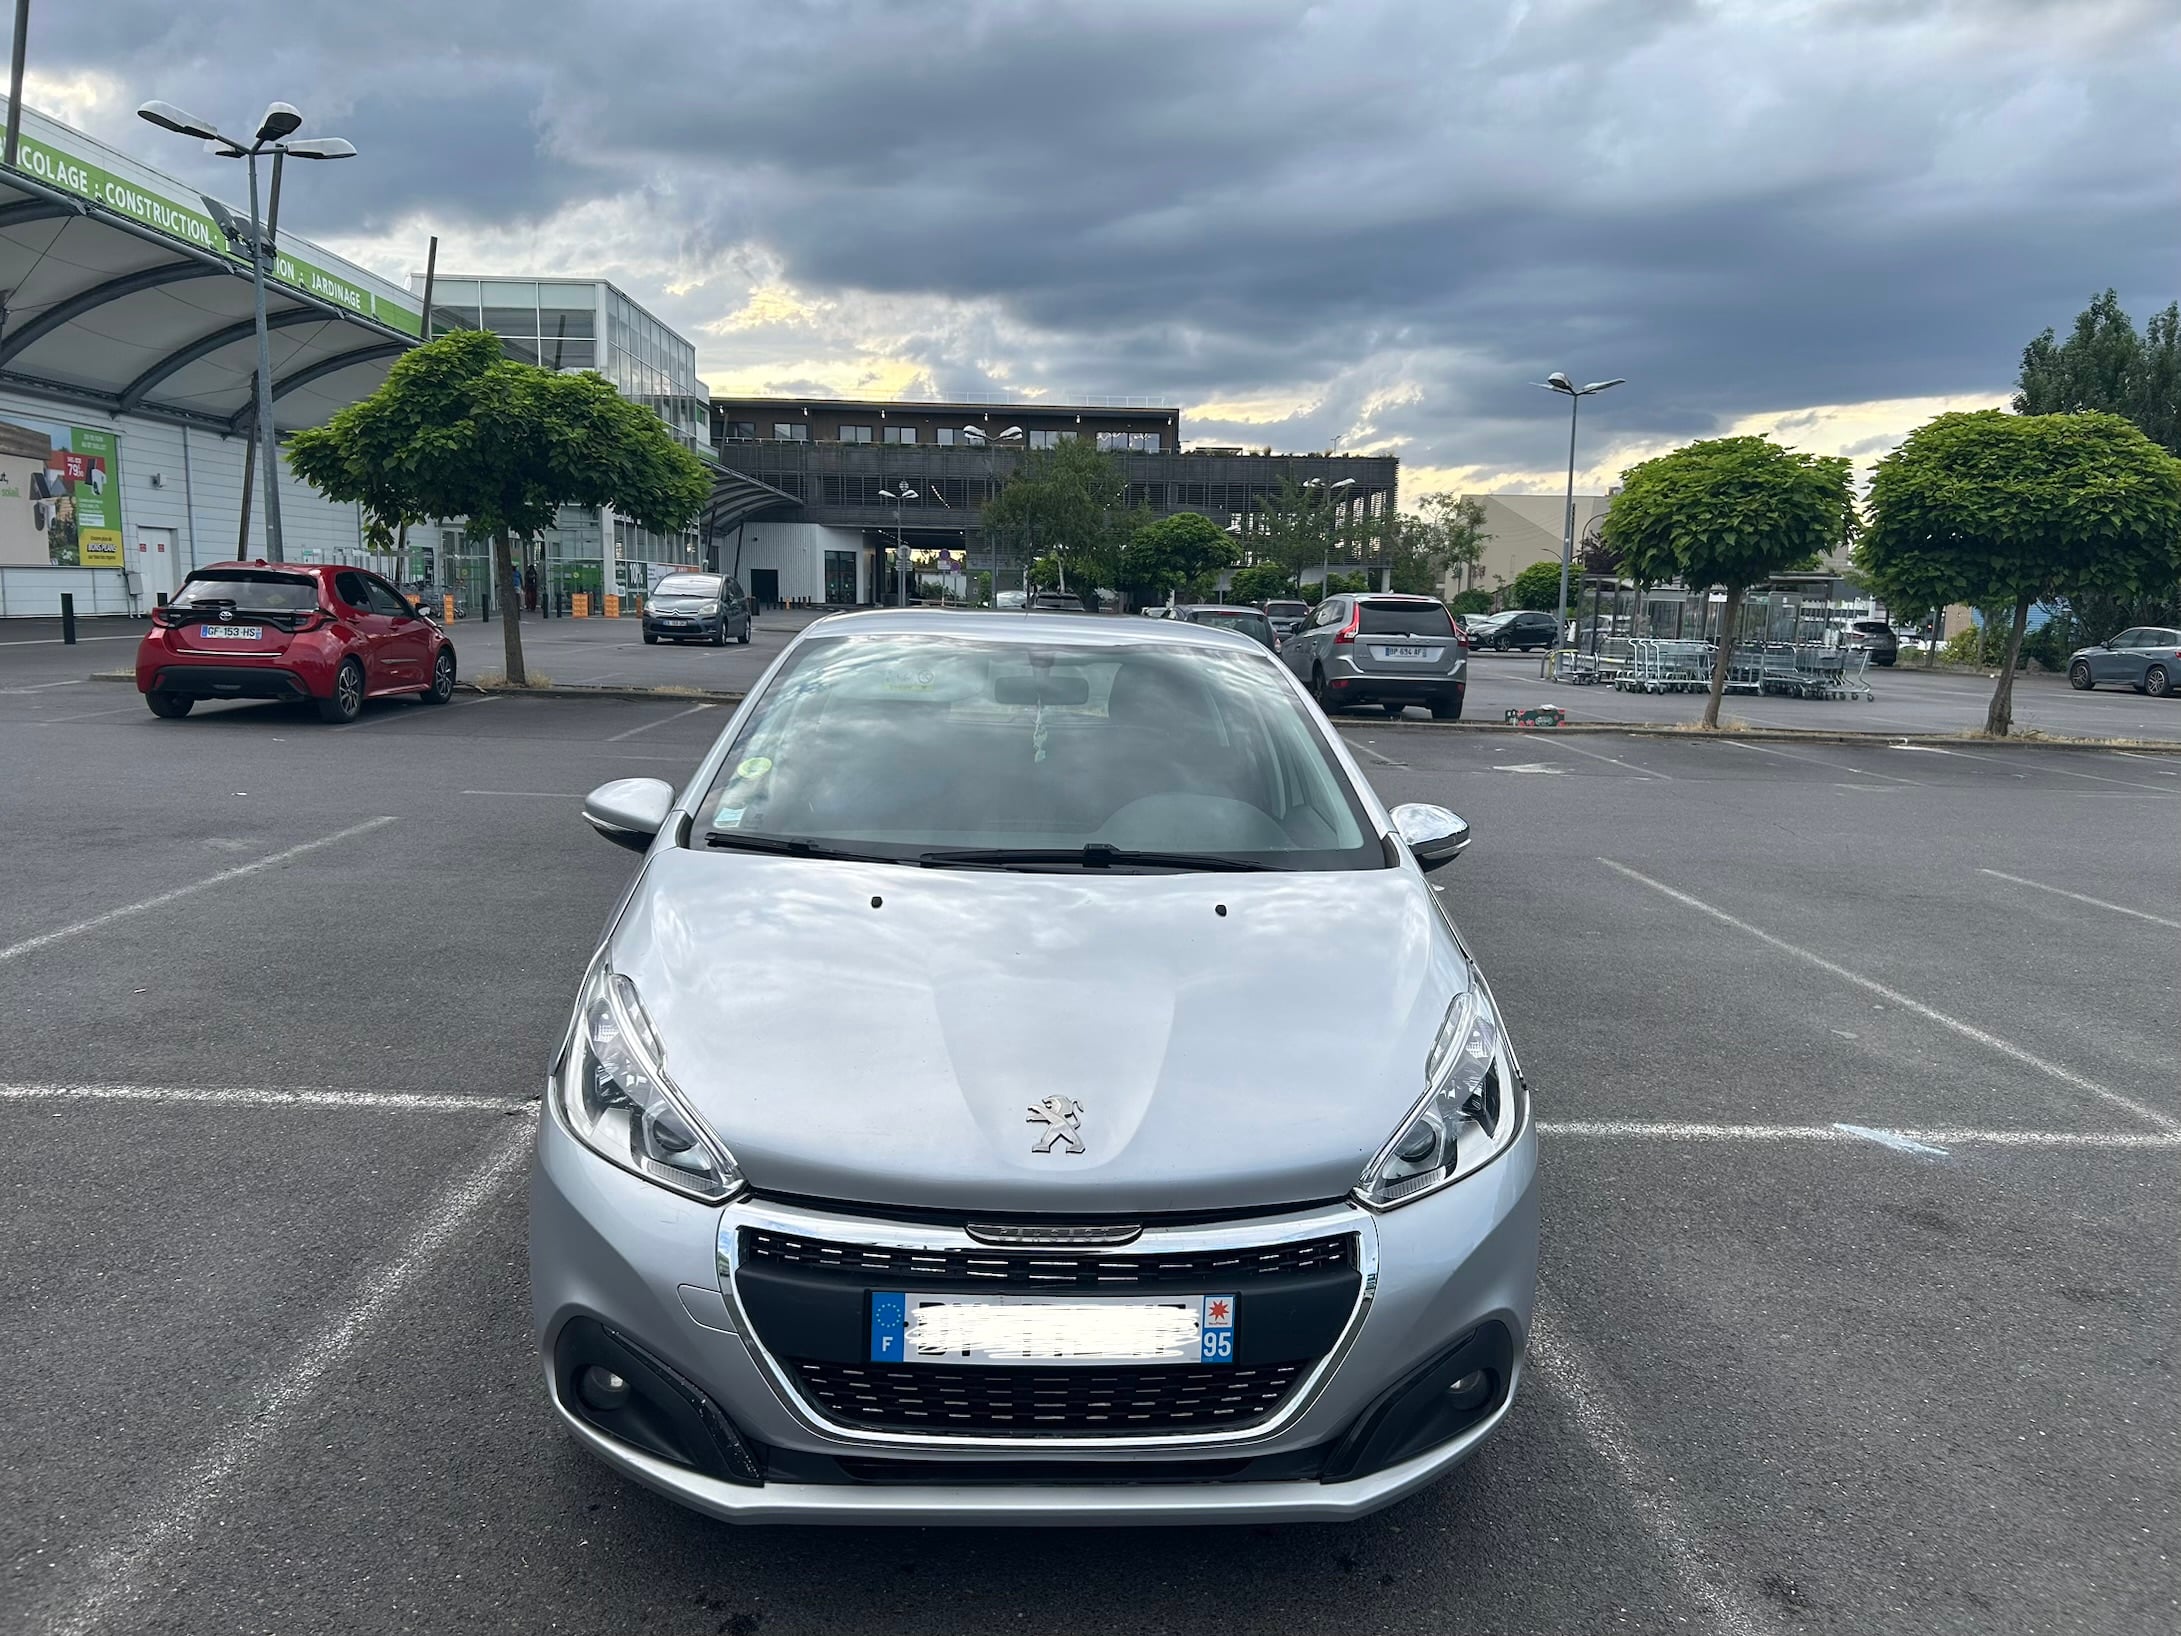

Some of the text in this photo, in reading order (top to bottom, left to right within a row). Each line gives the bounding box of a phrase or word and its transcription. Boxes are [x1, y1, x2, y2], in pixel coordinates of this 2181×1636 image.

[0, 137, 361, 309] ICOLAGE CONSTRUCTION JARDINAGE
[882, 1336, 893, 1351] F
[1203, 1331, 1232, 1357] 95
